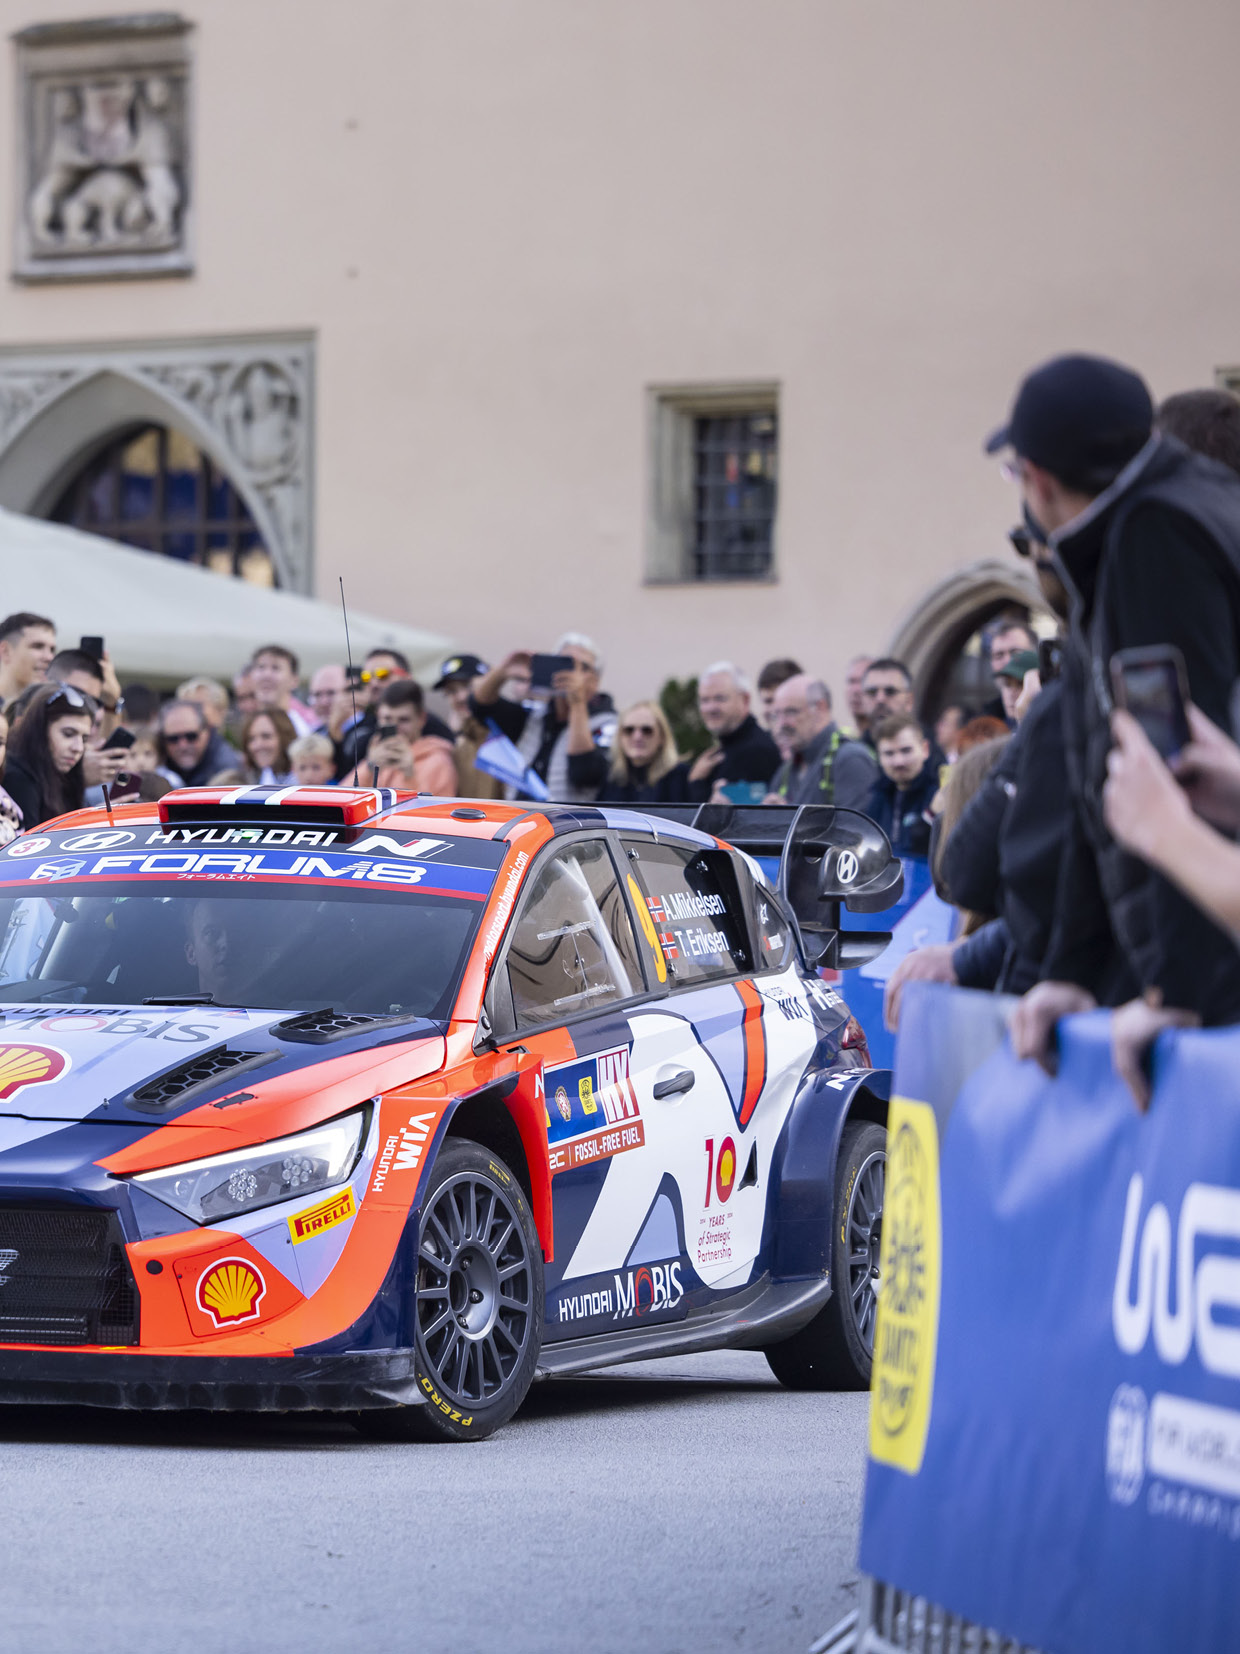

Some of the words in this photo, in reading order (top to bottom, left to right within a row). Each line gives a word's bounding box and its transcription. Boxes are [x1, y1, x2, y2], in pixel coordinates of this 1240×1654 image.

[145, 828, 339, 847] HYUNDAI
[89, 854, 427, 884] FORUM8
[661, 890, 726, 921] A.Mikkelsen
[674, 931, 690, 957] T.
[689, 928, 730, 956] Eriksen
[392, 1111, 437, 1171] WIA
[574, 1133, 621, 1162] FOSSIL-FREE
[621, 1126, 641, 1147] FUEL
[372, 1135, 400, 1192] HYUNDAI
[704, 1135, 737, 1208] 10
[293, 1194, 351, 1238] PIRELLI
[708, 1214, 726, 1228] YEARS
[698, 1230, 706, 1247] of
[706, 1227, 731, 1246] Strategic
[697, 1244, 732, 1263] Partnership
[559, 1289, 613, 1322] HYUNDAI
[613, 1261, 685, 1320] MOBIS
